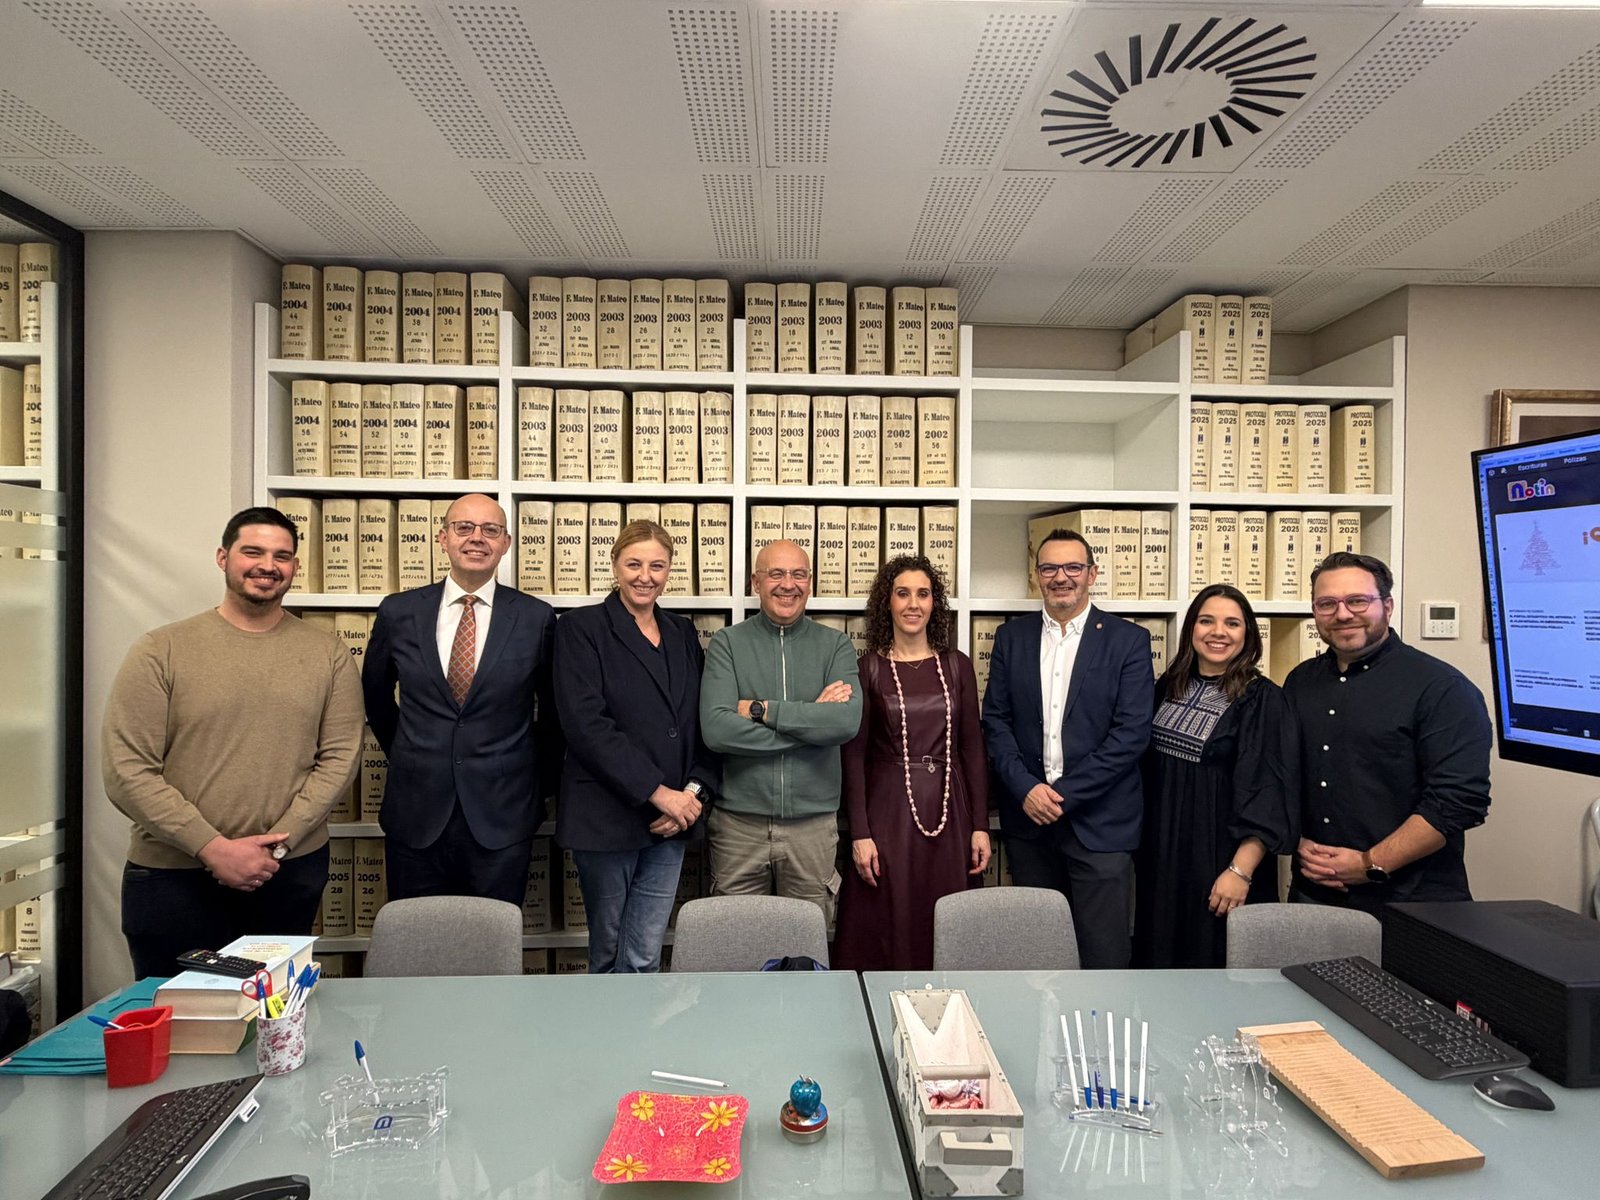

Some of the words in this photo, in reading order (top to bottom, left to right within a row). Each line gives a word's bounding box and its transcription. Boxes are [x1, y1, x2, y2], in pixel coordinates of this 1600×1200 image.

[332, 283, 354, 292] Mateo
[374, 287, 396, 296] Mateo
[479, 289, 501, 298] Mateo
[540, 294, 560, 303] Mateo
[607, 295, 627, 303] Mateo
[674, 295, 693, 303] Mateo
[754, 298, 773, 307] Mateo
[825, 298, 844, 307] Mateo
[283, 301, 308, 309] 2004
[326, 303, 352, 311] 2004
[905, 302, 923, 311] Mateo
[367, 306, 393, 315] 2004
[405, 308, 430, 316] 2004
[437, 307, 461, 315] 2004
[474, 308, 498, 316] 2004
[532, 311, 557, 320] 2003
[566, 312, 590, 321] 2003
[600, 313, 624, 321] 2003
[633, 314, 657, 323] 2003
[667, 313, 690, 322] 2003
[700, 313, 723, 322] 2003
[748, 316, 771, 325] 2003
[781, 317, 805, 326] 2003
[819, 316, 842, 325] 2003
[860, 320, 882, 329] 2003
[899, 320, 921, 329] 2003
[931, 321, 954, 330] 2003
[301, 398, 322, 406] Mateo
[339, 401, 359, 409] Mateo
[433, 401, 453, 409] Mateo
[529, 402, 549, 411] Mateo
[600, 406, 620, 414] Mateo
[642, 407, 662, 416] Mateo
[787, 410, 807, 418] Mateo
[295, 416, 319, 425] 2004
[860, 412, 879, 420] Mateo
[893, 412, 912, 420] Mateo
[332, 419, 356, 428] 2004
[363, 419, 388, 427] 2004
[393, 419, 417, 428] 2004
[426, 420, 450, 429] 2004
[470, 421, 494, 429] 2004
[522, 422, 546, 430] 2003
[559, 424, 583, 433] 2003
[594, 424, 617, 432] 2003
[636, 426, 659, 435] 2003
[669, 425, 692, 434] 2003
[705, 426, 728, 435] 2003
[750, 427, 773, 435] 2003
[781, 428, 804, 437] 2003
[817, 429, 840, 437] 2003
[853, 430, 876, 439] 2003
[887, 430, 910, 438] 2002
[925, 430, 948, 439] 2002
[1518, 463, 1548, 471] Escrituras
[529, 517, 548, 526] Mateo
[707, 519, 727, 528] Mateo
[827, 521, 845, 530] Mateo
[1121, 526, 1139, 534] Mateo
[325, 534, 348, 542] 2004
[361, 534, 383, 542] 2004
[401, 534, 425, 543] 2004
[522, 536, 545, 544] 2003
[557, 536, 581, 545] 2003
[592, 537, 615, 545] 2003
[701, 537, 724, 546] 2003
[820, 540, 843, 549] 2002
[852, 540, 875, 549] 2002
[890, 541, 913, 549] 2002
[930, 540, 953, 548] 2002
[1116, 545, 1136, 553] 2001
[1145, 545, 1166, 553] 2001
[365, 759, 388, 768] 2005
[364, 858, 383, 866] Mateo
[357, 873, 381, 882] 2005
